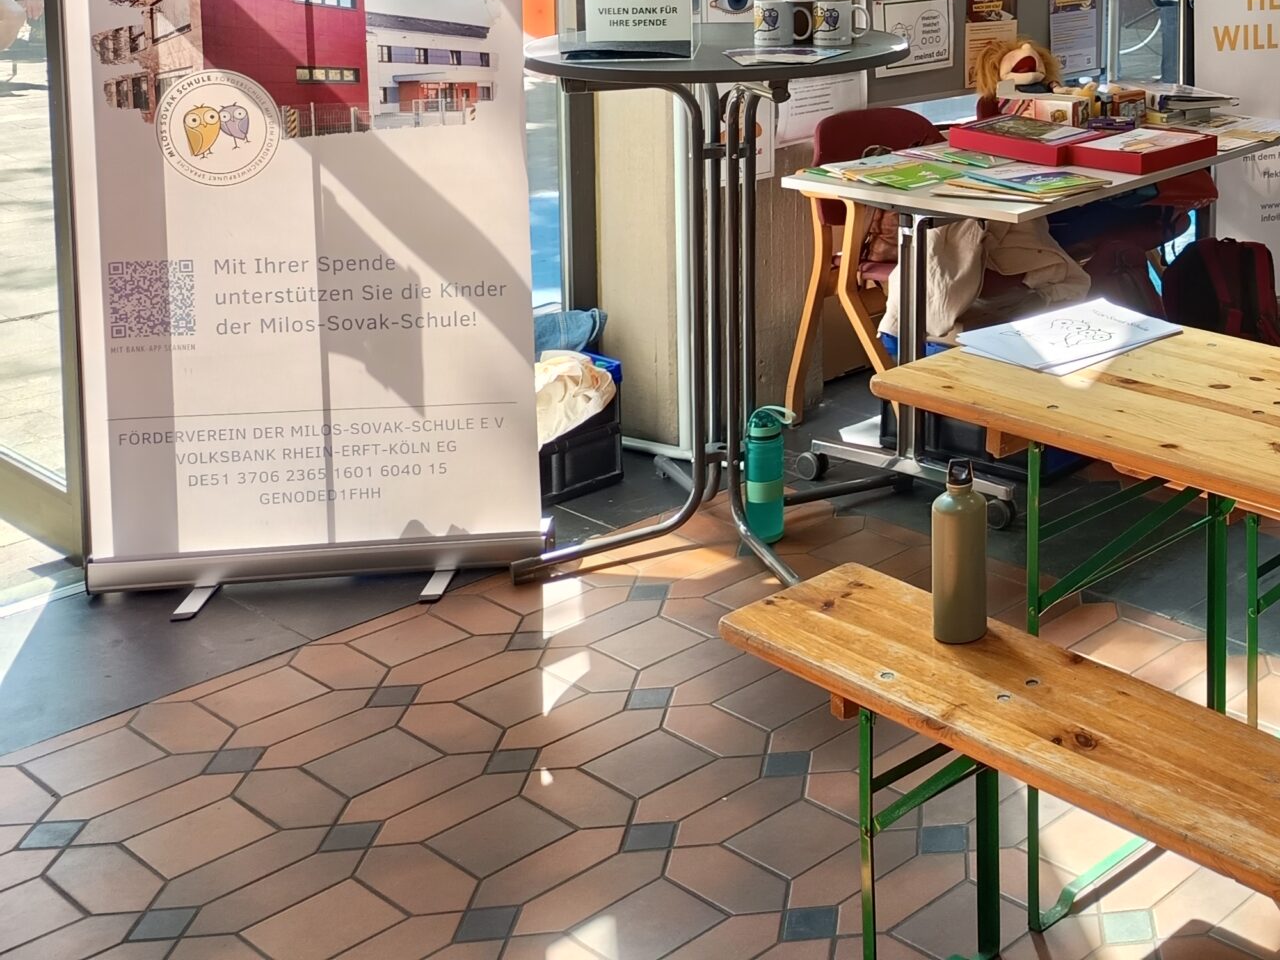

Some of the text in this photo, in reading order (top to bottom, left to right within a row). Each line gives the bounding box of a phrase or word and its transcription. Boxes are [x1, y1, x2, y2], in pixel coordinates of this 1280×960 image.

[597, 4, 678, 15] VIELEN DANK FÜR
[609, 18, 667, 27] IHRE SPENDE
[914, 48, 947, 61] meinst du?
[176, 74, 212, 95] SCHULE
[159, 95, 178, 126] SOVAK
[159, 129, 176, 158] MILOS
[1242, 153, 1256, 162] mit
[1257, 152, 1276, 161] dem
[213, 254, 397, 276] Mit Ihrer Spende
[215, 280, 508, 306] unterstützen Sie die Kinder
[215, 310, 479, 337] der Milos-Sovak-Schule!
[118, 415, 506, 447] FÖRDERVEREIN DER MILOS-SOVAK-SCHULE E V
[175, 438, 459, 467] VOLKSBANK RHEIN-ERFT-KÖLN EG
[187, 461, 449, 488] DE51 3706 2365 1601 6040 15
[258, 487, 383, 506] GENODED1FHH
